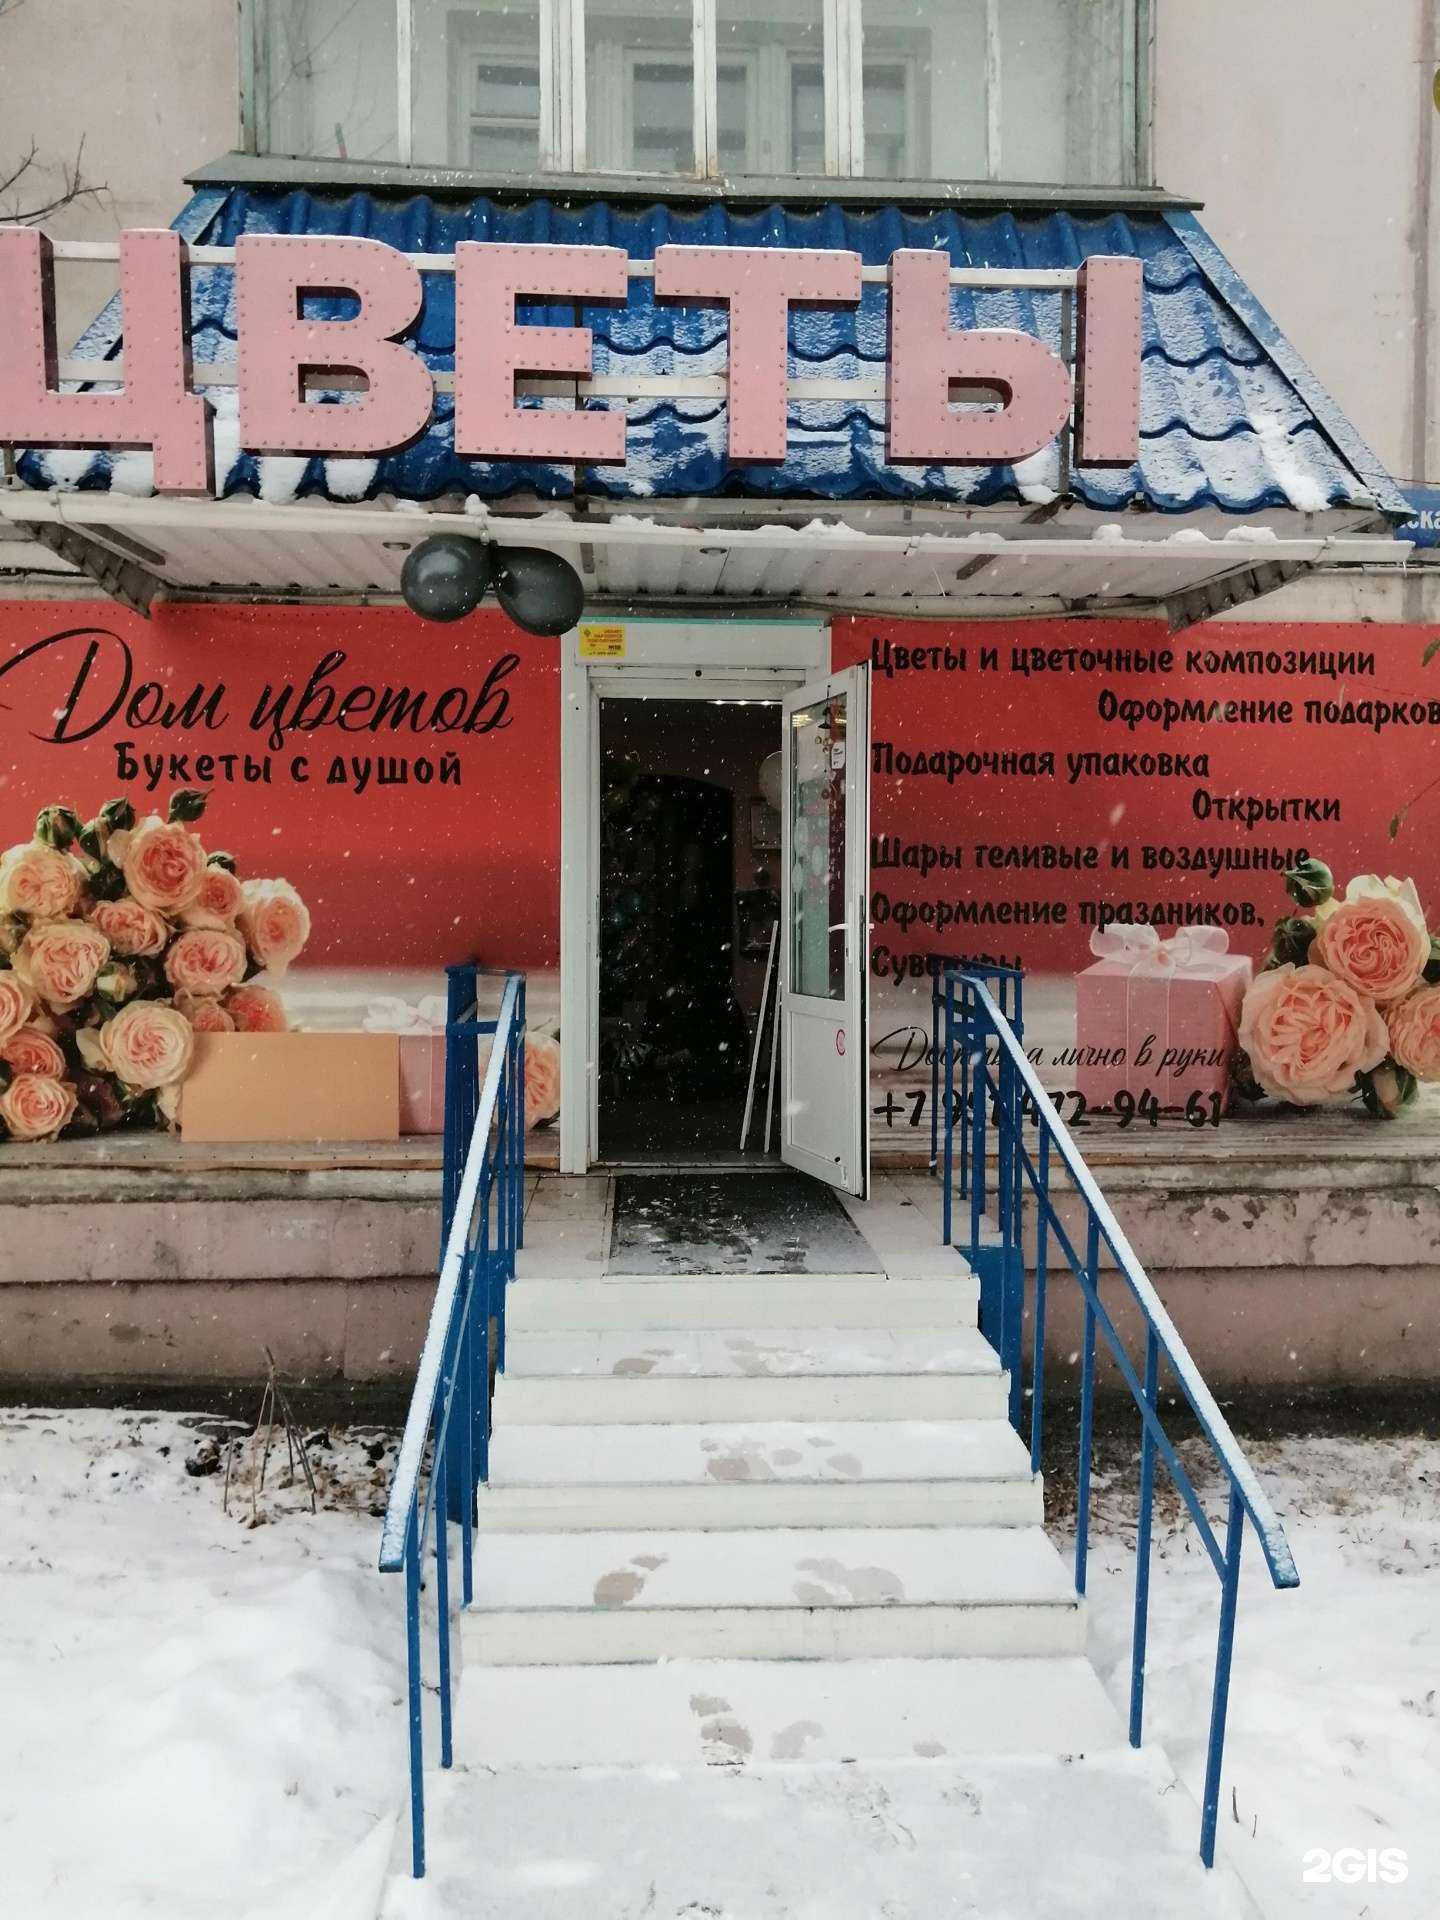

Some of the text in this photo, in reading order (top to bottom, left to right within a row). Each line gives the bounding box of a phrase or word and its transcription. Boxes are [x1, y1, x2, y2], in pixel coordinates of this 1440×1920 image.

[0, 226, 1143, 493] ЦВЕТЫ
[871, 638, 1375, 680] Цветы и цветочные композиции
[0, 628, 520, 750] Дом цветов
[1100, 689, 1440, 734] Оформление подарков
[114, 741, 462, 794] Букеты с душой
[871, 742, 1055, 784] Подарочная
[1067, 748, 1210, 783] упаковка
[1192, 788, 1340, 830] Открытки
[870, 837, 962, 878] Шары
[1111, 846, 1129, 869] и
[1142, 846, 1310, 879] воздушные
[870, 892, 1264, 934] Оформление праздников,
[1052, 1045, 1127, 1067] лично
[1134, 1034, 1157, 1067] в
[1155, 1048, 1225, 1077] руки
[872, 1090, 926, 1128] +7
